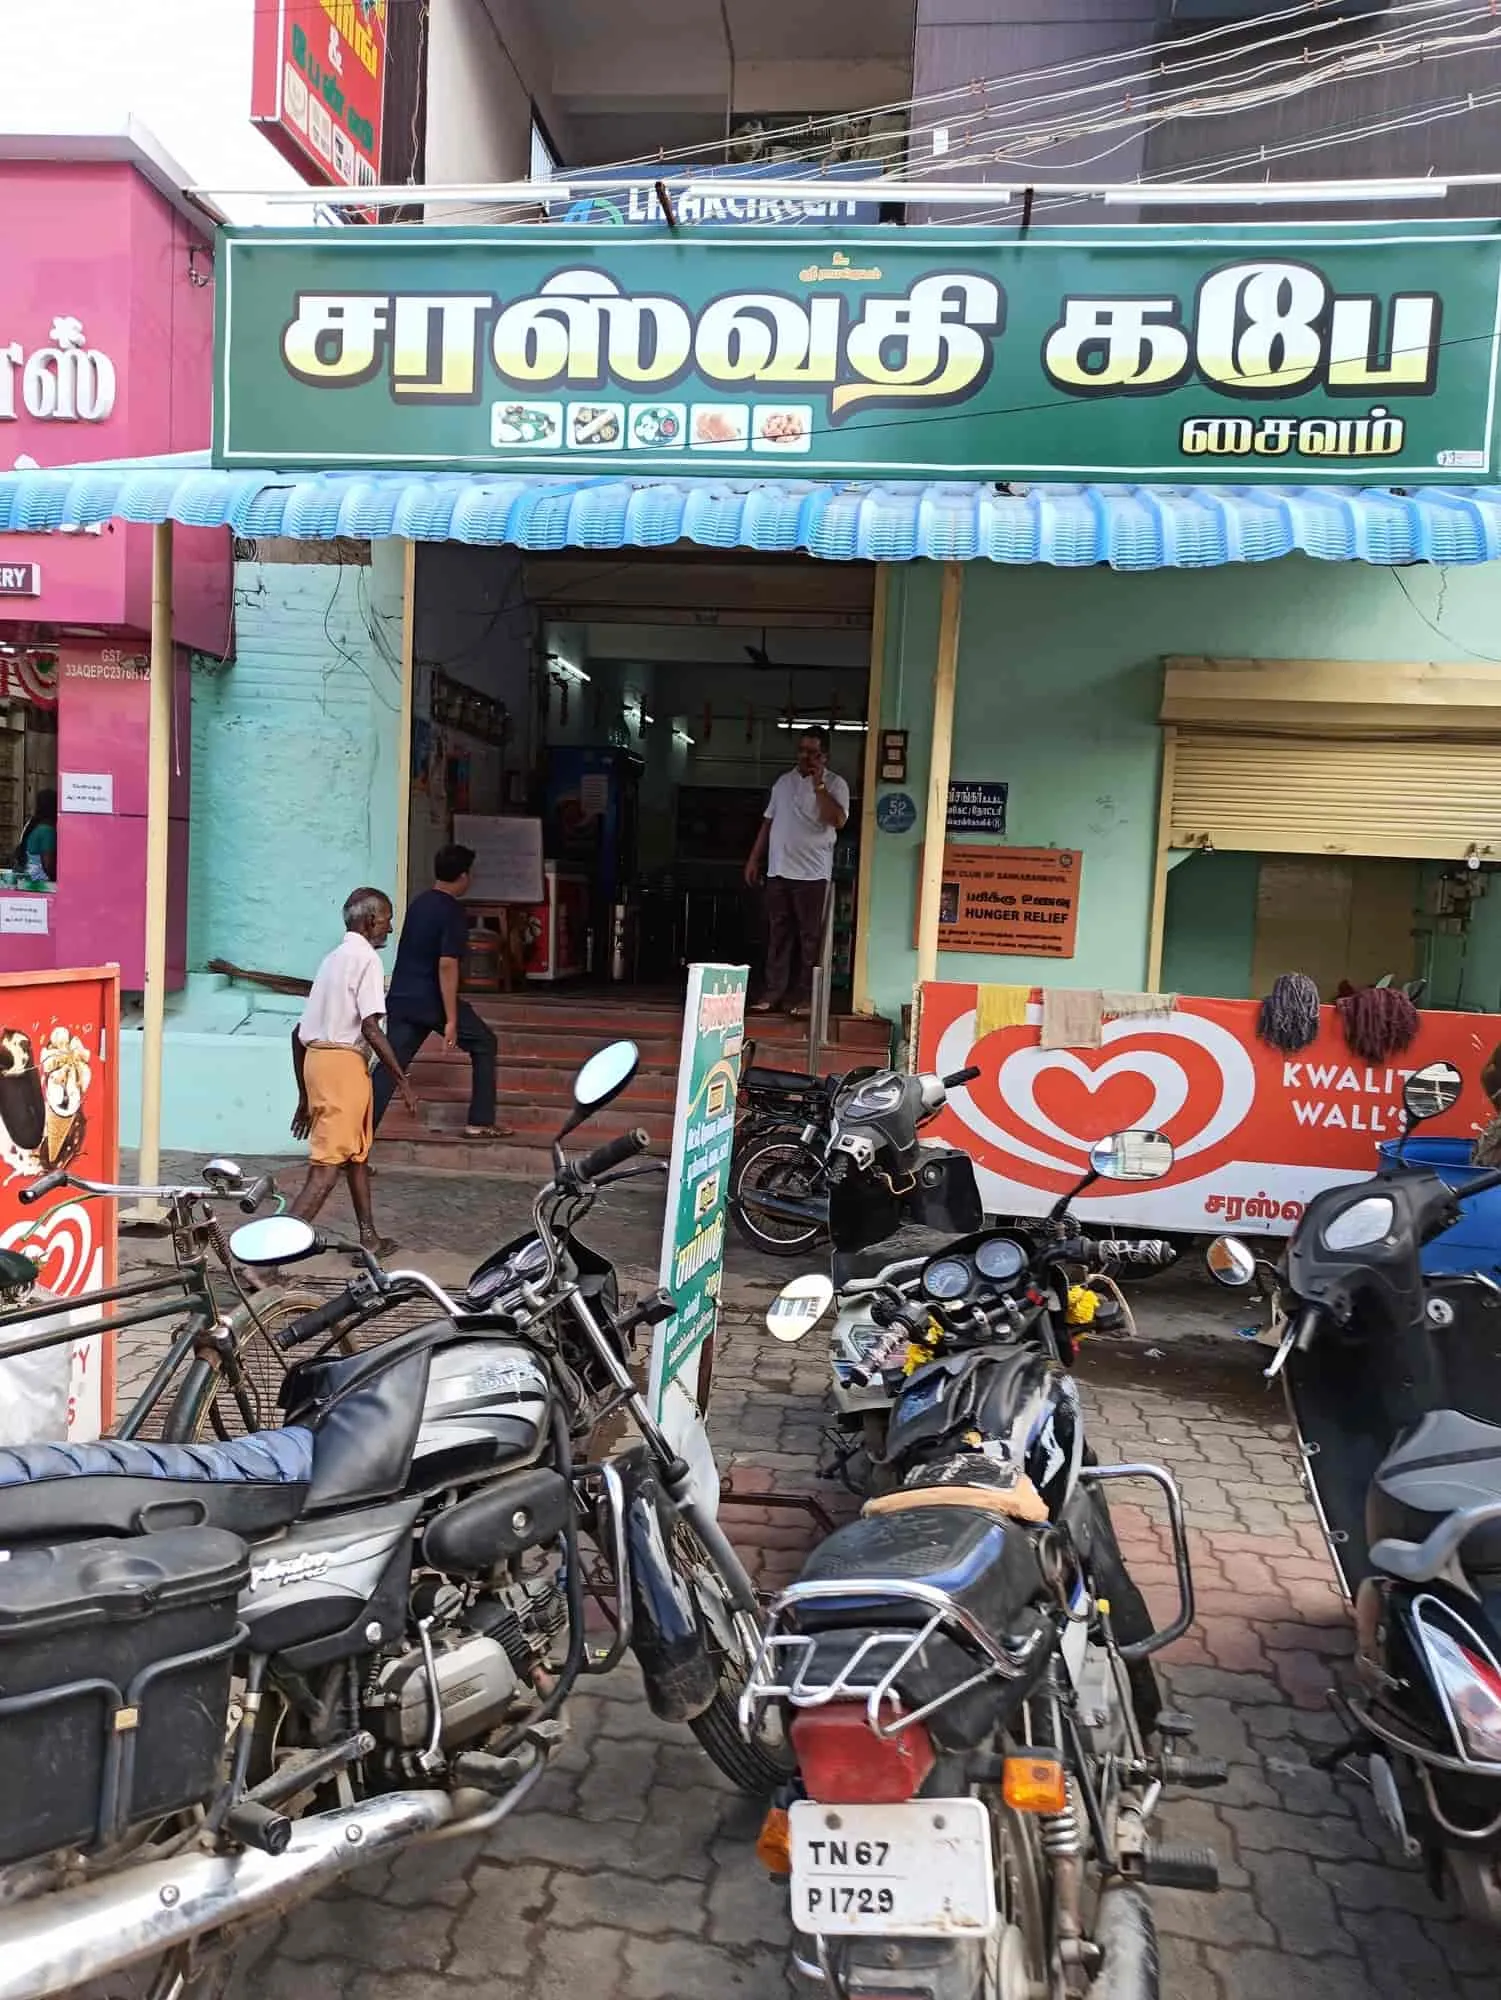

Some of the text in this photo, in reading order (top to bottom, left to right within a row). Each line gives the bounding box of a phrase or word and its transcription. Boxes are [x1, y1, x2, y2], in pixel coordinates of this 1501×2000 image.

[282, 262, 1438, 415] சரஸ்வதி கபே
[1181, 406, 1404, 456] சைவம்
[101, 649, 122, 663] GST
[965, 907, 1070, 924] HUNGER RELIEF
